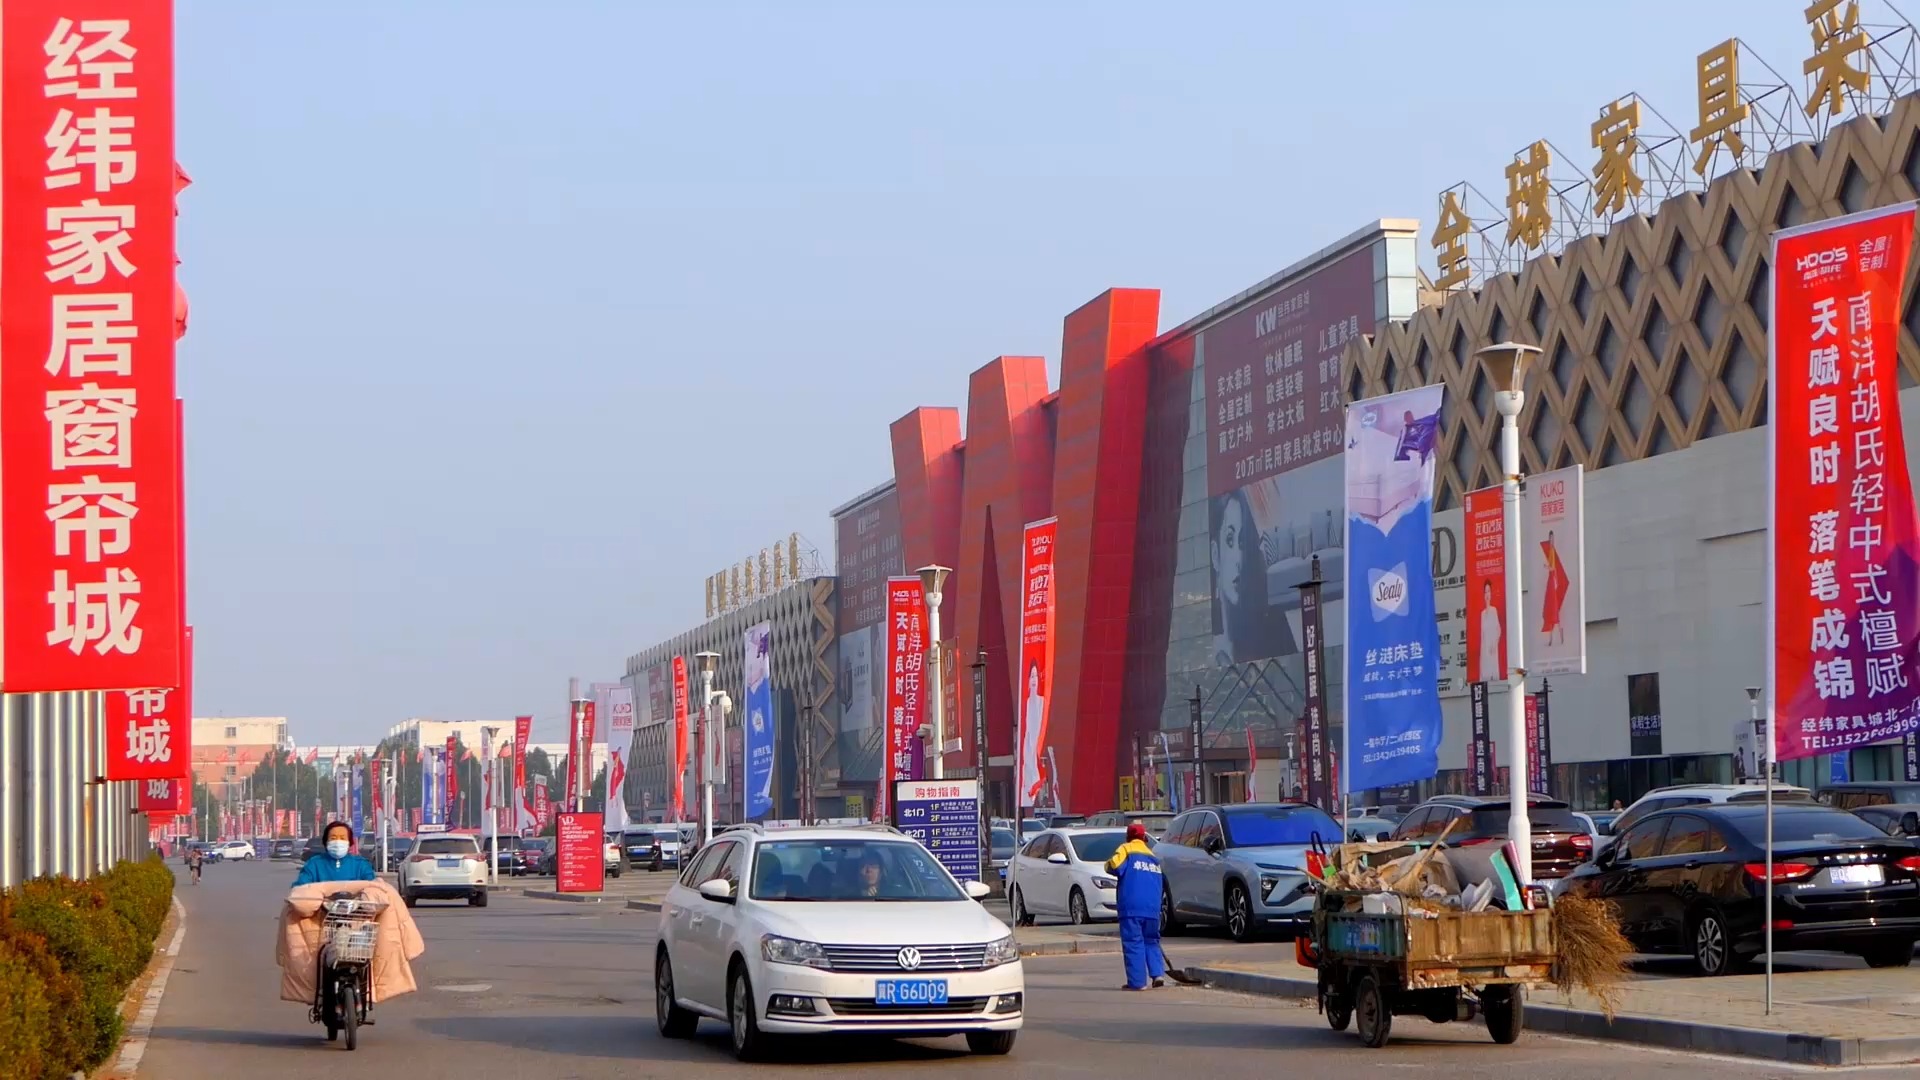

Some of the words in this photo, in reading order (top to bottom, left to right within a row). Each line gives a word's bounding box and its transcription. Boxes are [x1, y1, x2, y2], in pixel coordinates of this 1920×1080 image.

[1859, 235, 1887, 254] 全屋
[1860, 254, 1883, 272] 定制
[1256, 305, 1276, 339] KW
[43, 17, 143, 656] 经纬家居窗帘城
[1265, 340, 1303, 376] 软体睡眠
[1318, 315, 1359, 353] 儿童家具
[1807, 296, 1841, 485] 天赋良时
[1847, 290, 1908, 699] 南洋胡氏轻中式檀赋
[1376, 578, 1404, 602] Sealy
[1808, 508, 1854, 700] 落笔成锦
[1365, 641, 1424, 666] 丝涟床垫
[915, 787, 960, 798] 购物指南
[903, 808, 925, 817] 北1门
[930, 803, 940, 811] 1F
[931, 828, 941, 836] 1F
